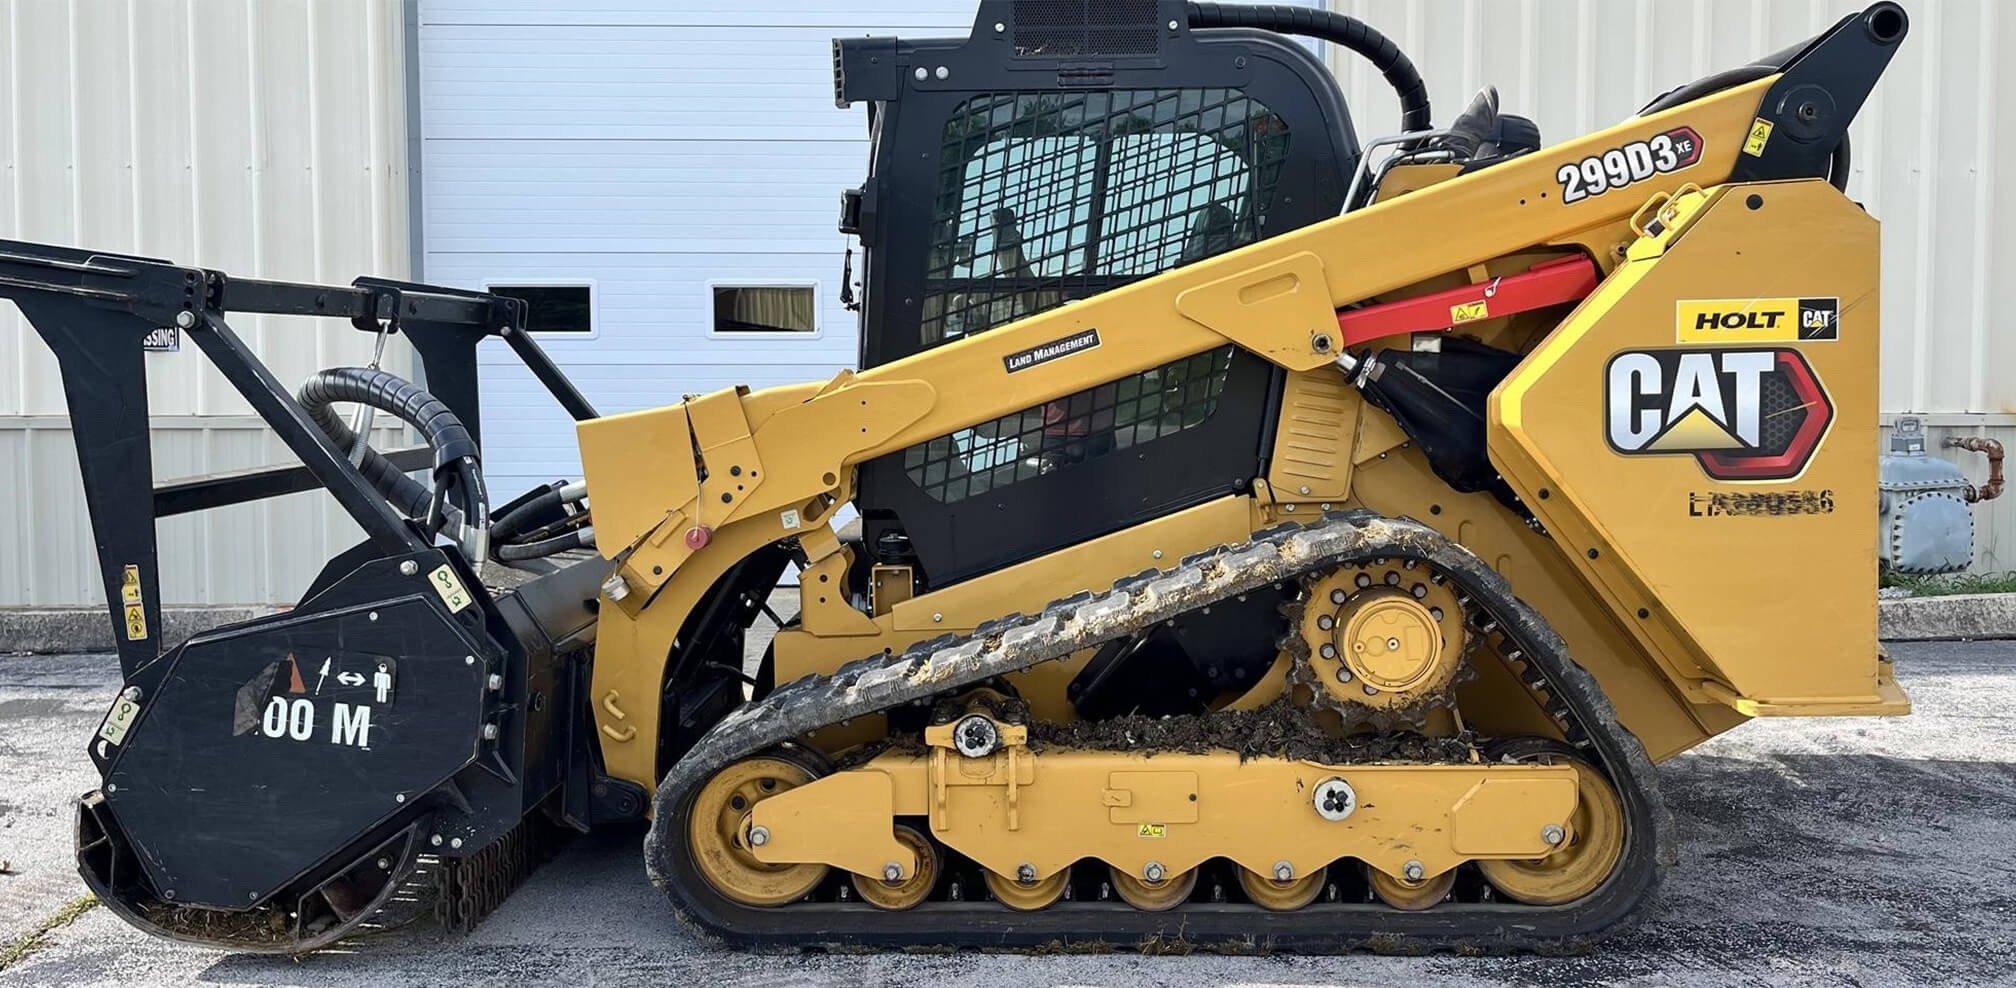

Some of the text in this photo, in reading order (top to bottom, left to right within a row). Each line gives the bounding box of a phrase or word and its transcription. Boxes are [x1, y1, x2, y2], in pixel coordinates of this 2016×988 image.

[1557, 134, 1693, 203] 299D3 XE
[143, 328, 175, 346] SSING
[1695, 310, 1832, 330] HOLT CAT
[1009, 334, 1094, 369] LAND MANAGEMENT
[1609, 351, 1775, 450] CAT
[331, 702, 371, 747] M
